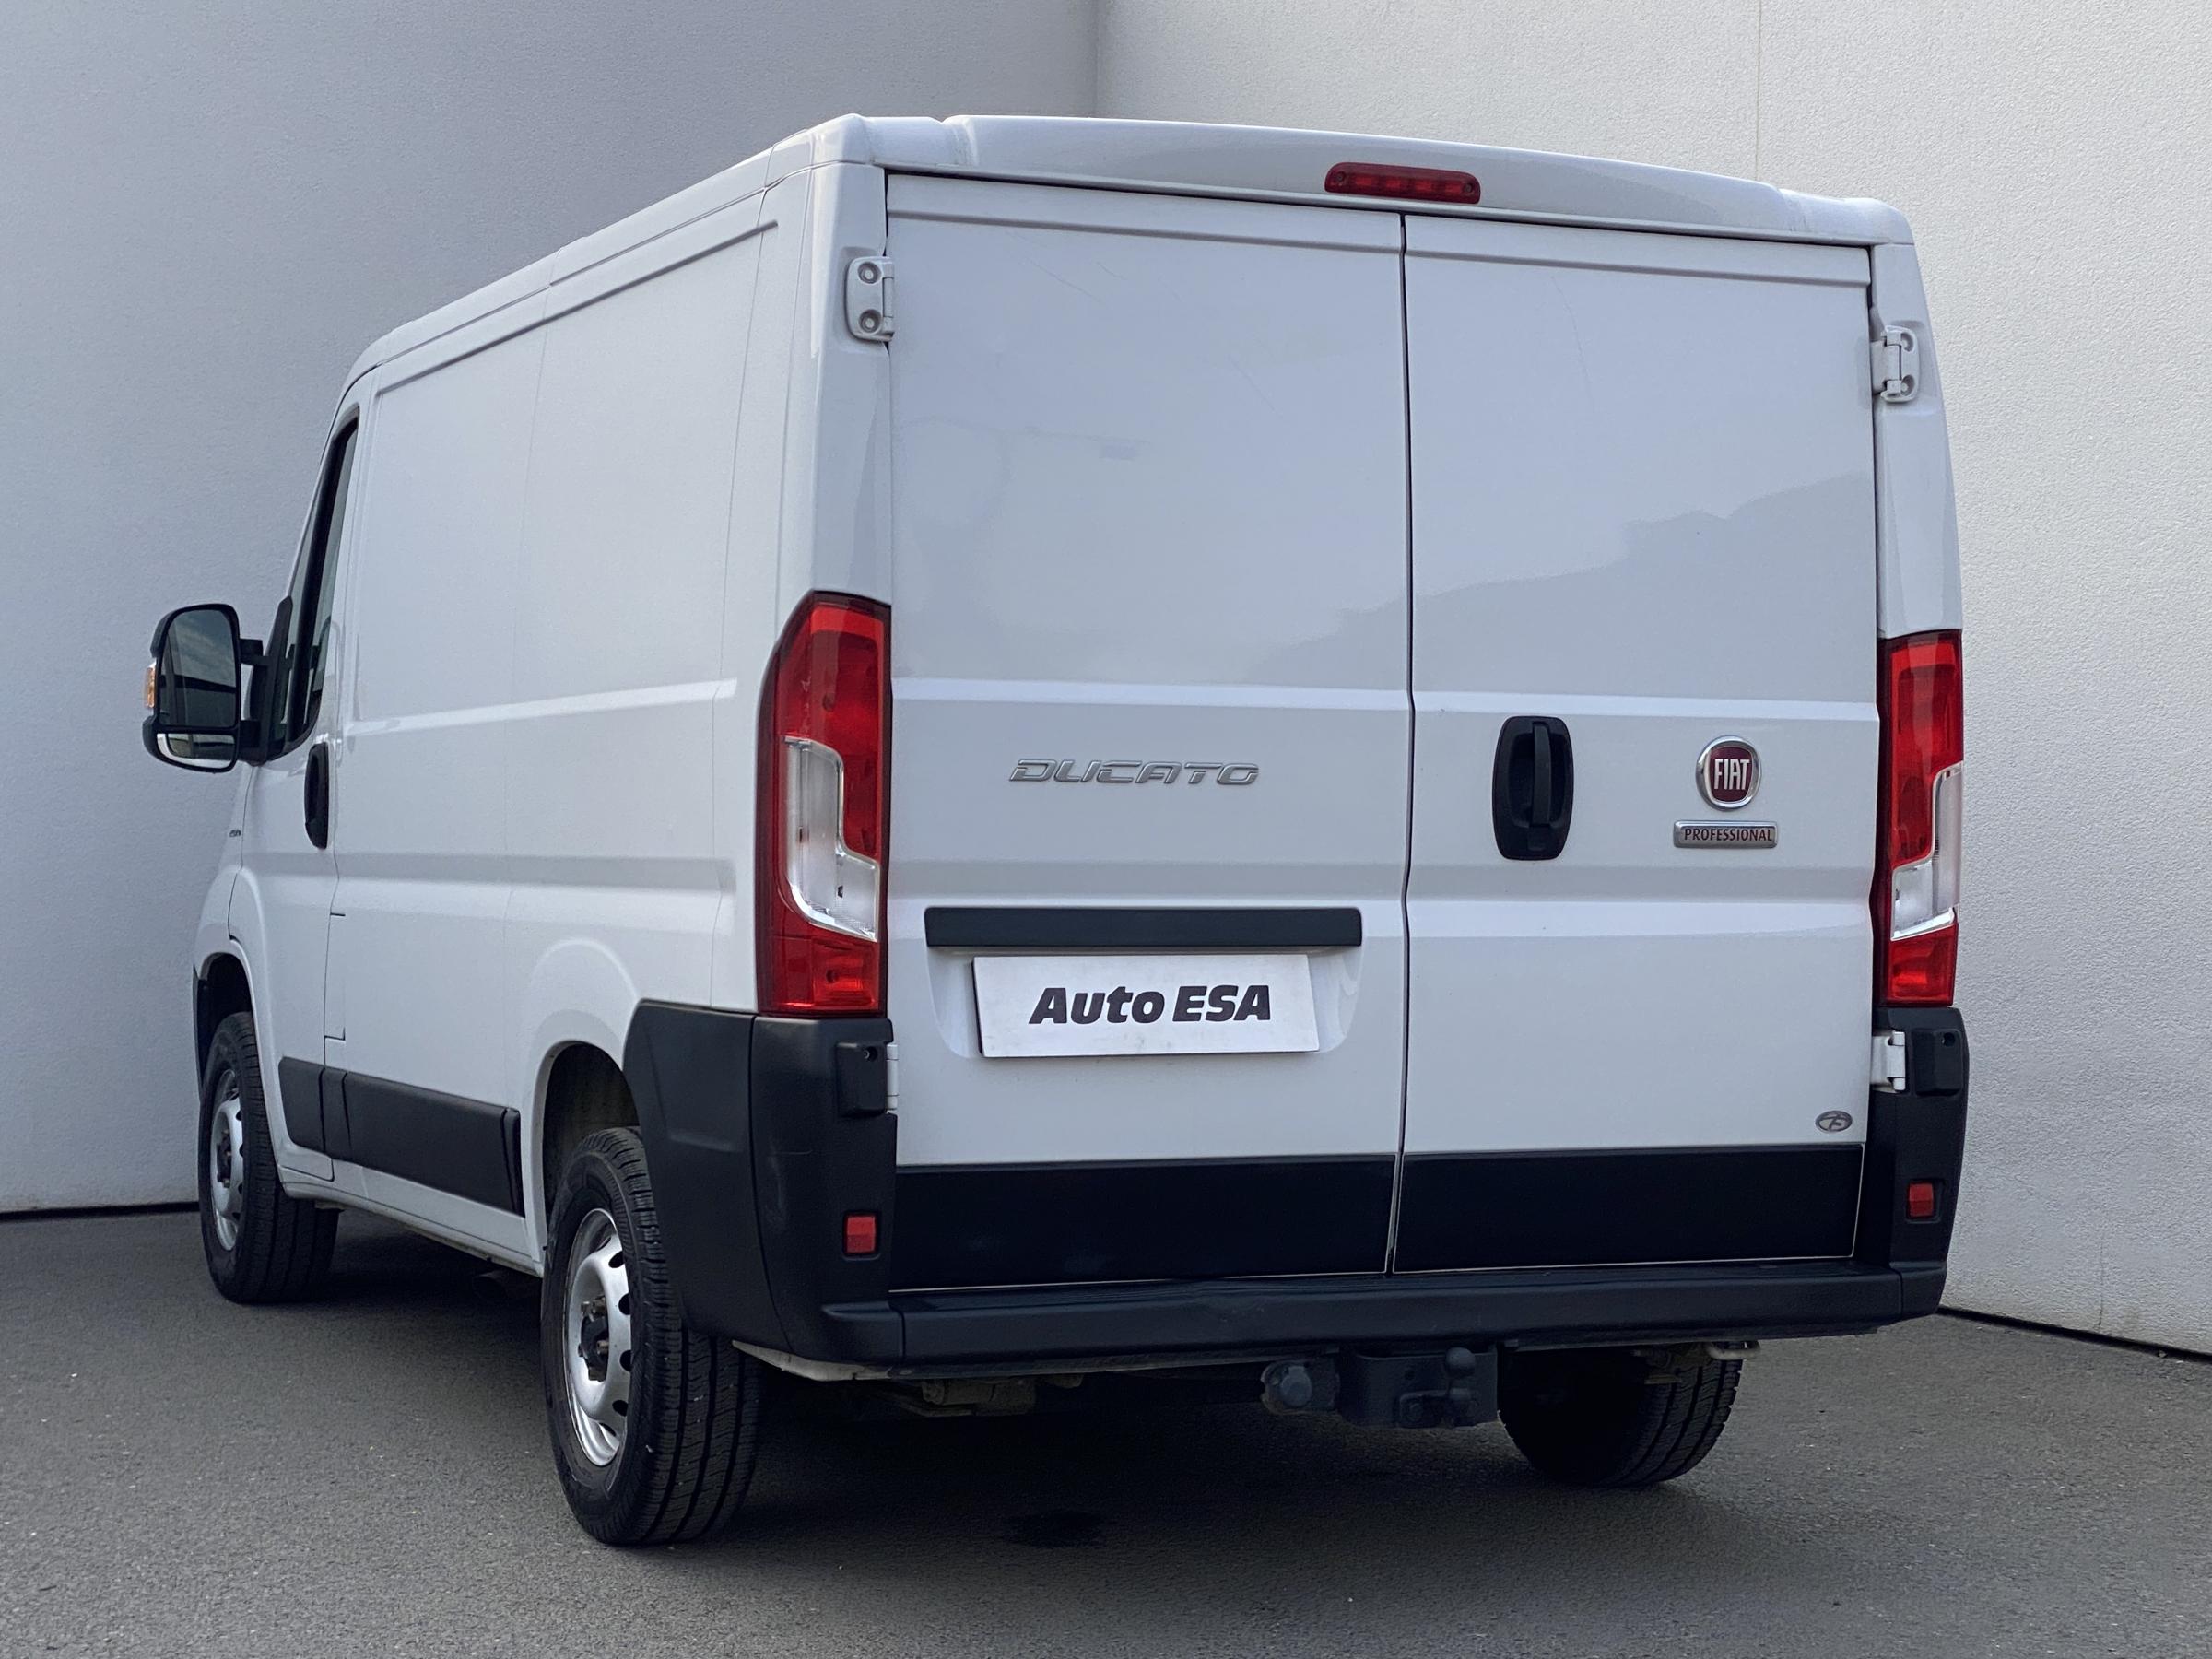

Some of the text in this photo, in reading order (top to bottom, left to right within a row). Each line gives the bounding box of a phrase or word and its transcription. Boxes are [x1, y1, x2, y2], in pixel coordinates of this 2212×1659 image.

[1009, 759, 1260, 785] DUCATO
[1713, 759, 1750, 790] FIAT
[1684, 829, 1773, 841] PROFESSIONAL
[1028, 984, 1271, 1025] Auto ESA
